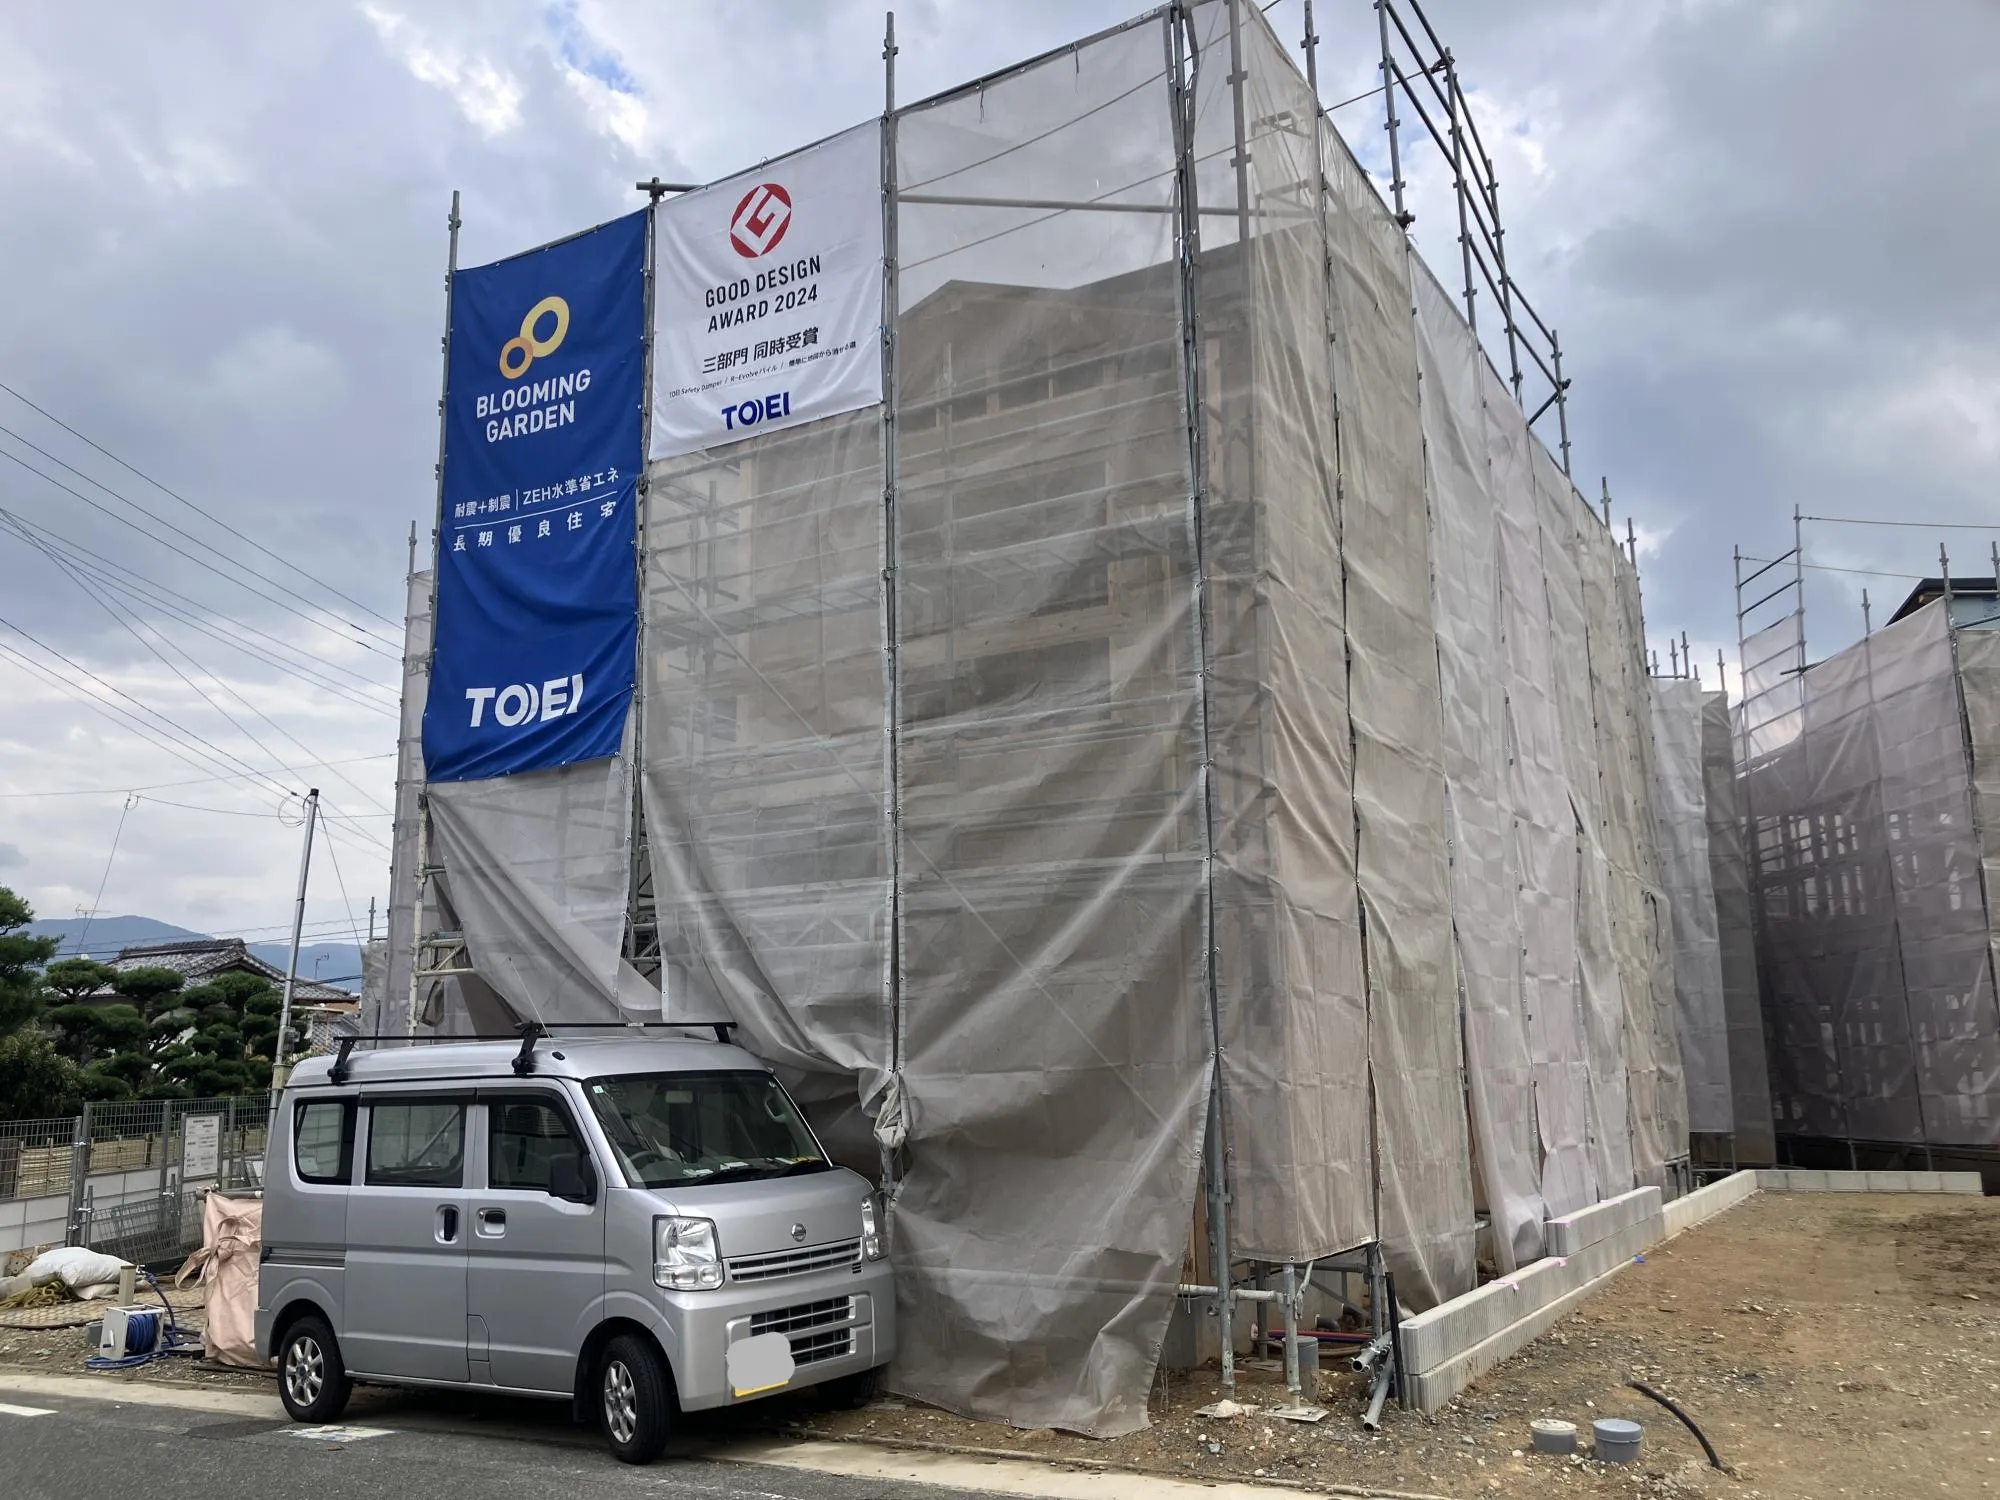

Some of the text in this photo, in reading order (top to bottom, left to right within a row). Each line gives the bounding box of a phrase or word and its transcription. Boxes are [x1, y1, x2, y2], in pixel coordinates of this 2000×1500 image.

[705, 254, 821, 308] GOOD DESIGN
[707, 283, 818, 334] AWARD 2024
[702, 326, 819, 375] 三部門 同時受賞
[476, 368, 591, 419] BLOOMING
[681, 385, 700, 395] Safety
[721, 391, 791, 430] TOEI
[486, 400, 575, 443] GARDEN
[522, 467, 620, 506] ZEH水準省エネ
[453, 500, 617, 552] 長期優良住宅
[465, 673, 584, 728] TOEI
